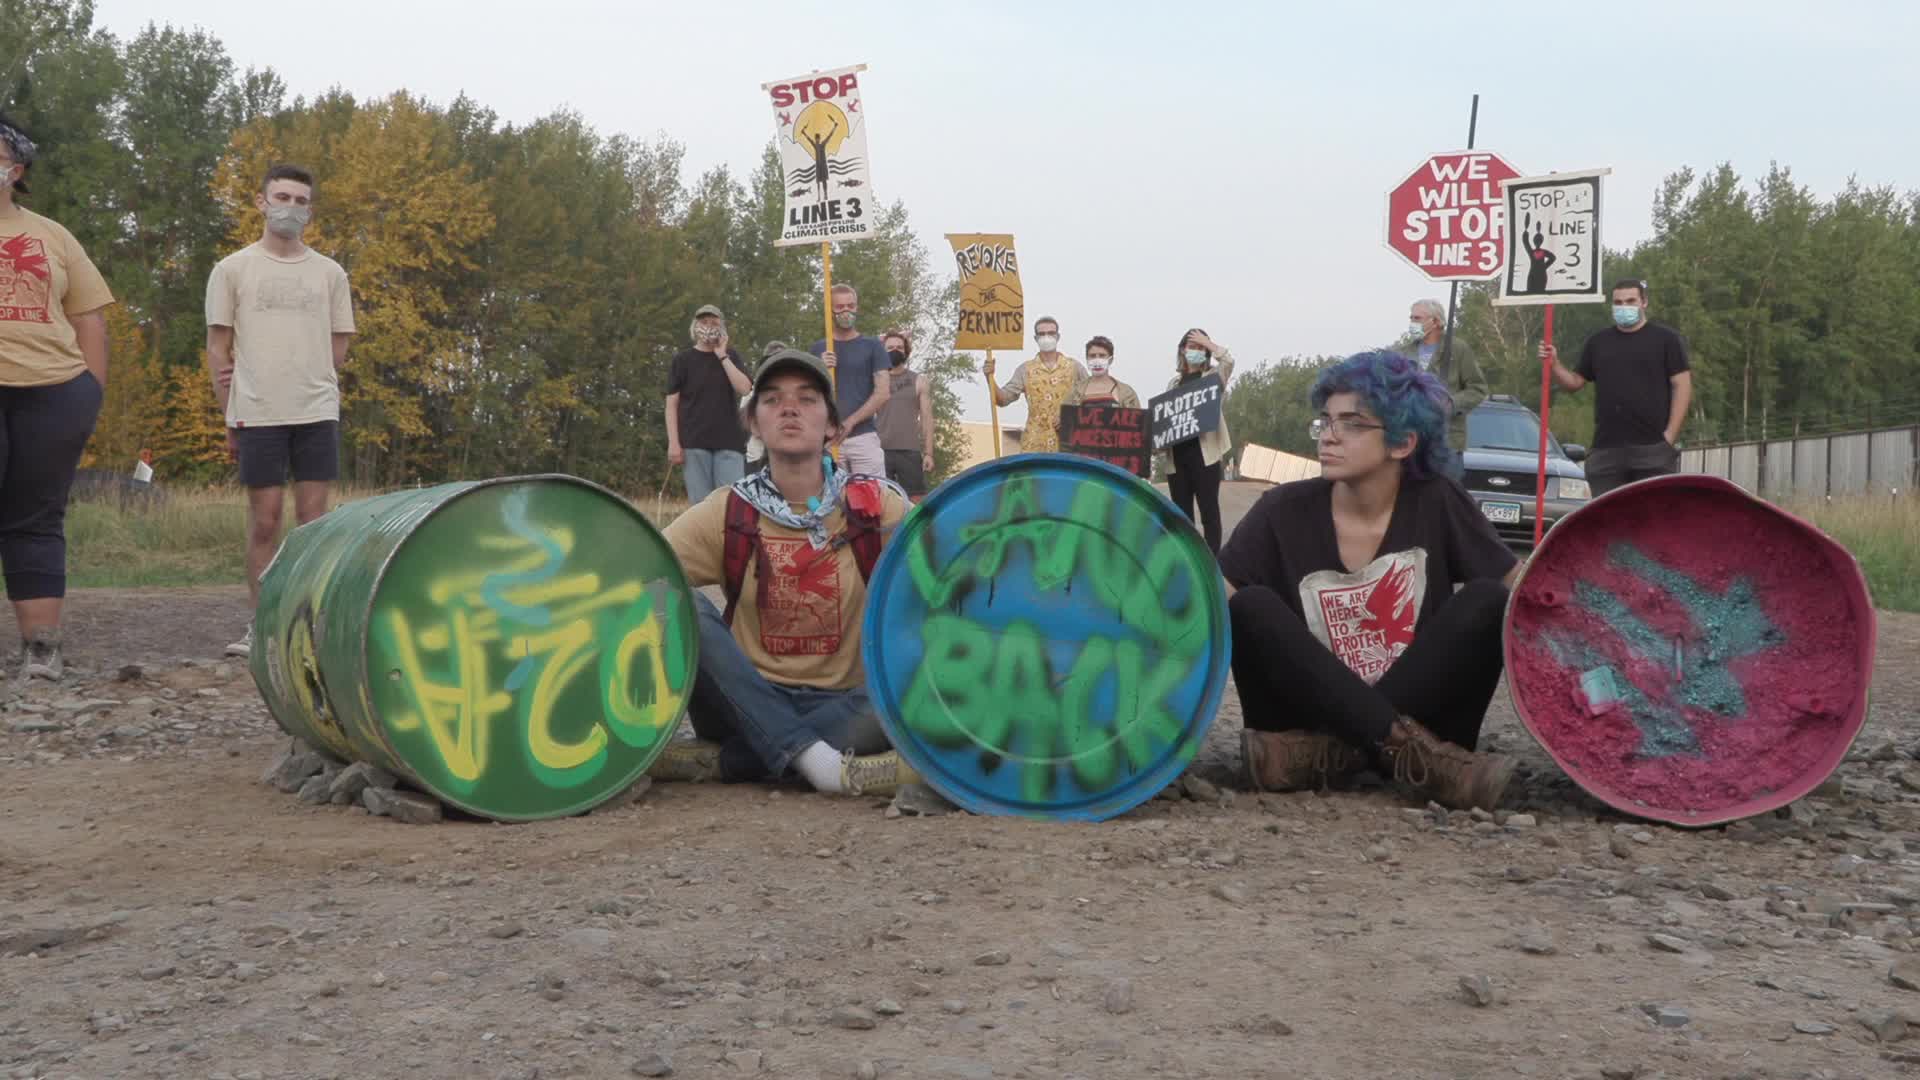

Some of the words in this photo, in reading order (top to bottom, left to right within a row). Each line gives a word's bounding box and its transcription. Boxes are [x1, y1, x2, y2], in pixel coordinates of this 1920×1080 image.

[770, 73, 857, 107] STOP
[1429, 155, 1491, 181] WE
[1418, 181, 1503, 209] WILL
[1519, 190, 1565, 210] STOP
[789, 200, 842, 226] LINE
[846, 198, 863, 219] 3
[784, 226, 830, 239] CLIMATE
[830, 223, 867, 235] CRISIS
[1549, 220, 1587, 236] LINE
[955, 243, 1017, 279] REVOKE
[1418, 242, 1472, 267] LINE
[1478, 241, 1498, 271] 3
[1563, 243, 1581, 267] 3
[979, 288, 996, 303] THE
[958, 309, 1023, 335] PERMITS
[1154, 385, 1218, 422] PROTECT
[1079, 408, 1104, 426] WE
[1110, 409, 1138, 427] ARE
[1170, 410, 1195, 426] THE
[1153, 420, 1200, 448] WATER
[905, 474, 1212, 654] LAND
[1323, 594, 1344, 609] WE
[1349, 589, 1368, 606] ARE
[1328, 606, 1360, 623] HERE
[1331, 623, 1349, 637] TO
[1335, 631, 1386, 653] PROTECT
[1353, 660, 1382, 676] TER
[902, 615, 1196, 802] BACK
